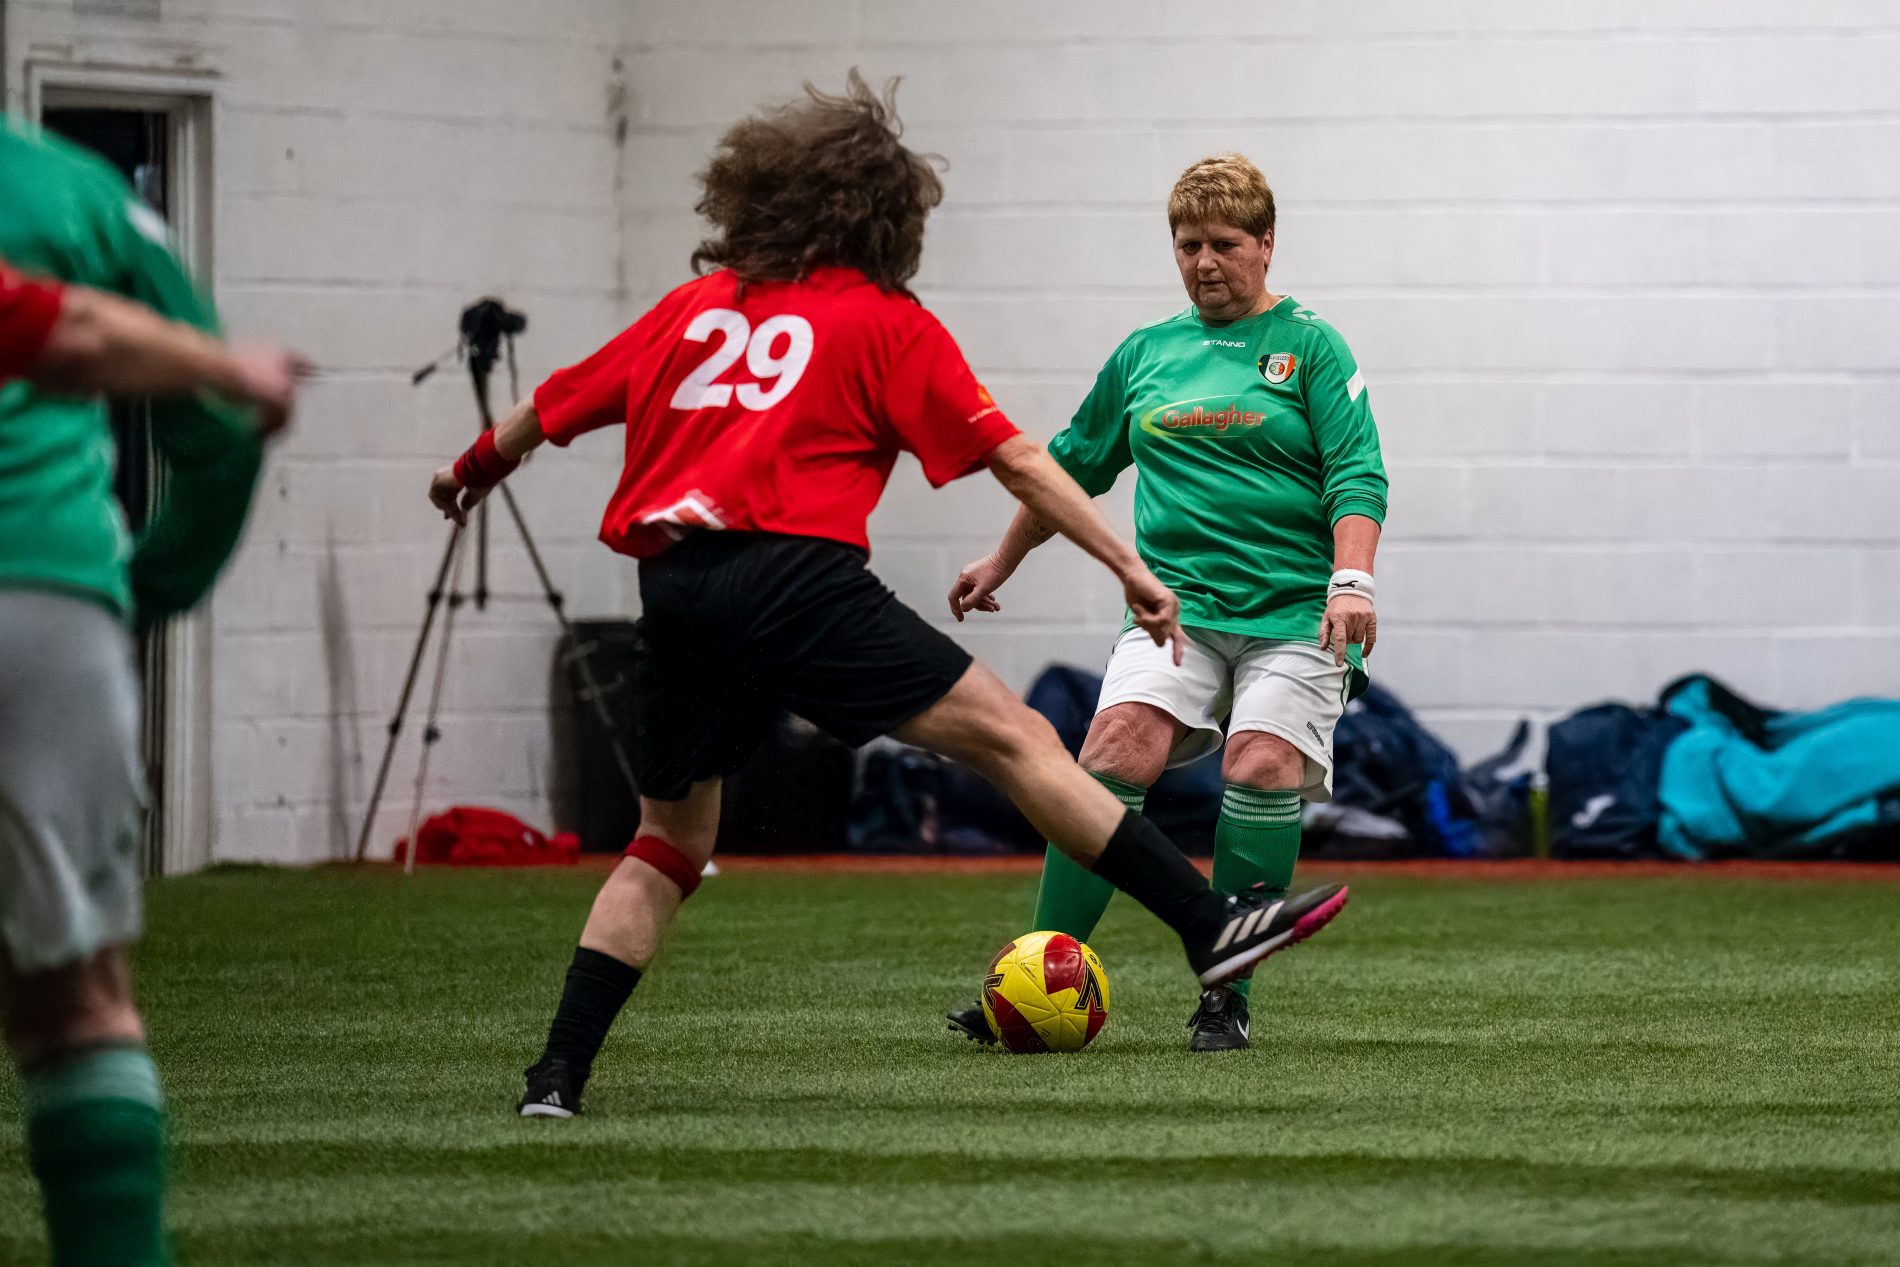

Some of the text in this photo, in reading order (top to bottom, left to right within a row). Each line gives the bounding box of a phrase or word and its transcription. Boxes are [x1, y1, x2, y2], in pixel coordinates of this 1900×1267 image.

[1202, 339, 1246, 348] STANNO
[670, 308, 814, 411] 29
[1162, 404, 1267, 431] Gallagher
